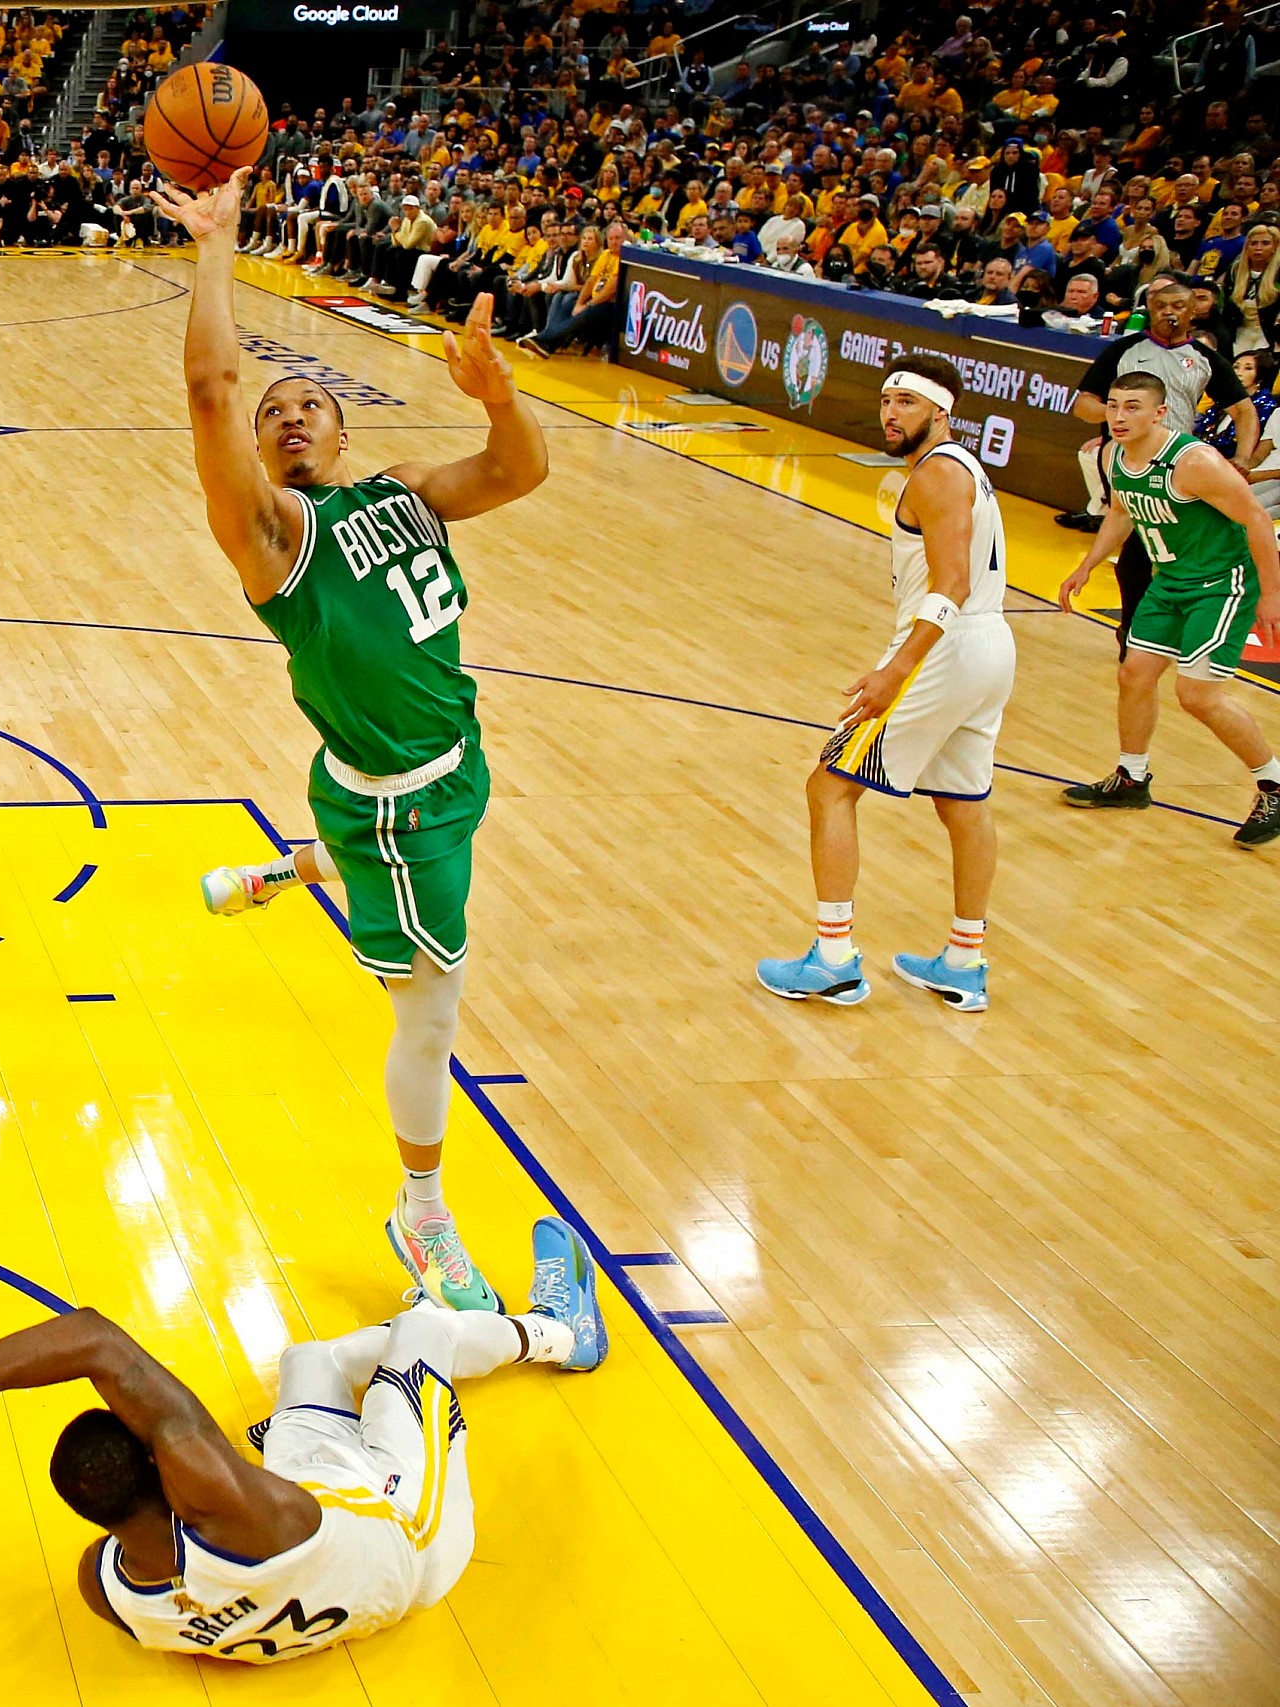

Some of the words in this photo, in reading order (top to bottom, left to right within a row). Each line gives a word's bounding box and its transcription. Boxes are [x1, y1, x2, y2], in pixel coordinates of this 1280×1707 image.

[293, 5, 350, 26] Google
[352, 5, 399, 21] Cloud
[630, 290, 708, 356] Finals
[840, 330, 888, 369] GAME
[331, 492, 447, 582] BOSTON
[385, 548, 464, 645] 12
[178, 1595, 259, 1646] GREEN
